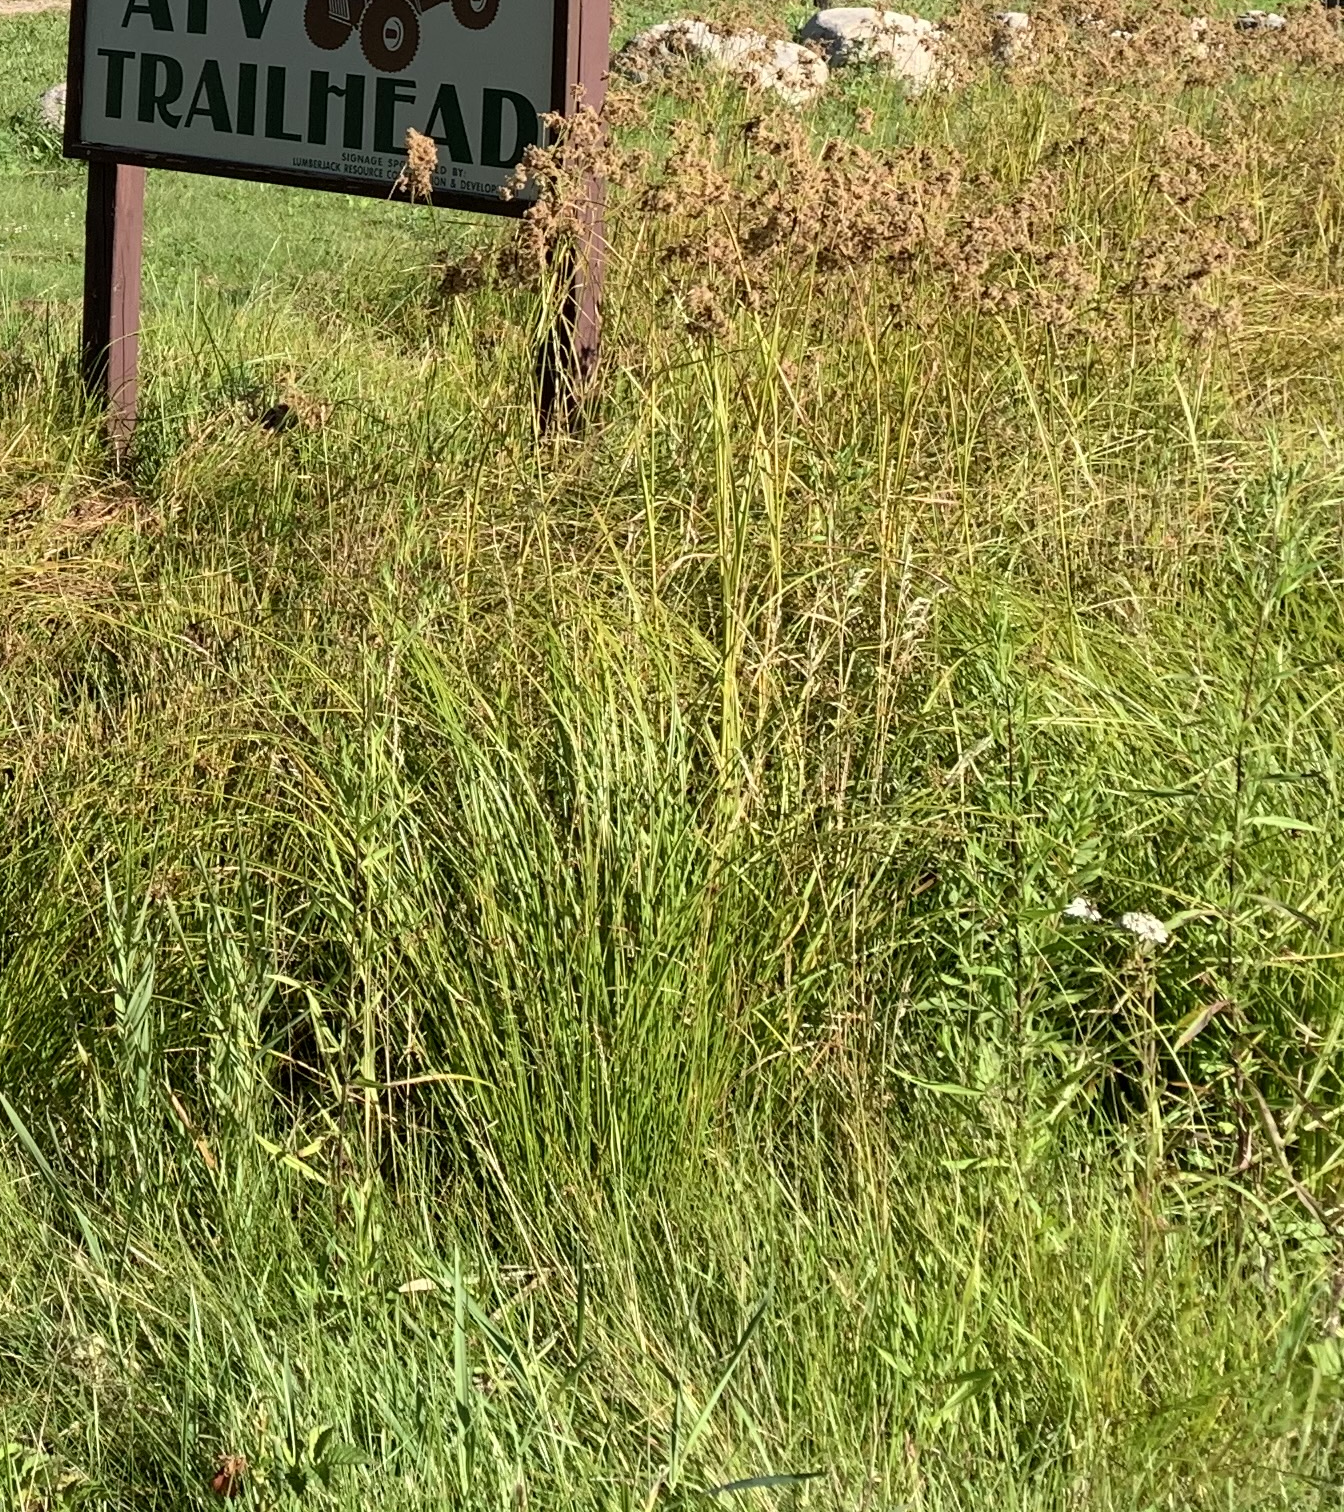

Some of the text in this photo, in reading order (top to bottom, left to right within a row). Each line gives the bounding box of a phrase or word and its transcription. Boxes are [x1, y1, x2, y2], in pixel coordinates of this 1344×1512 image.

[97, 48, 539, 169] TRAILHEAD
[292, 157, 341, 173] LUMBERJACK
[343, 163, 383, 178] RESOURCE
[341, 152, 383, 166] SIGNAGE
